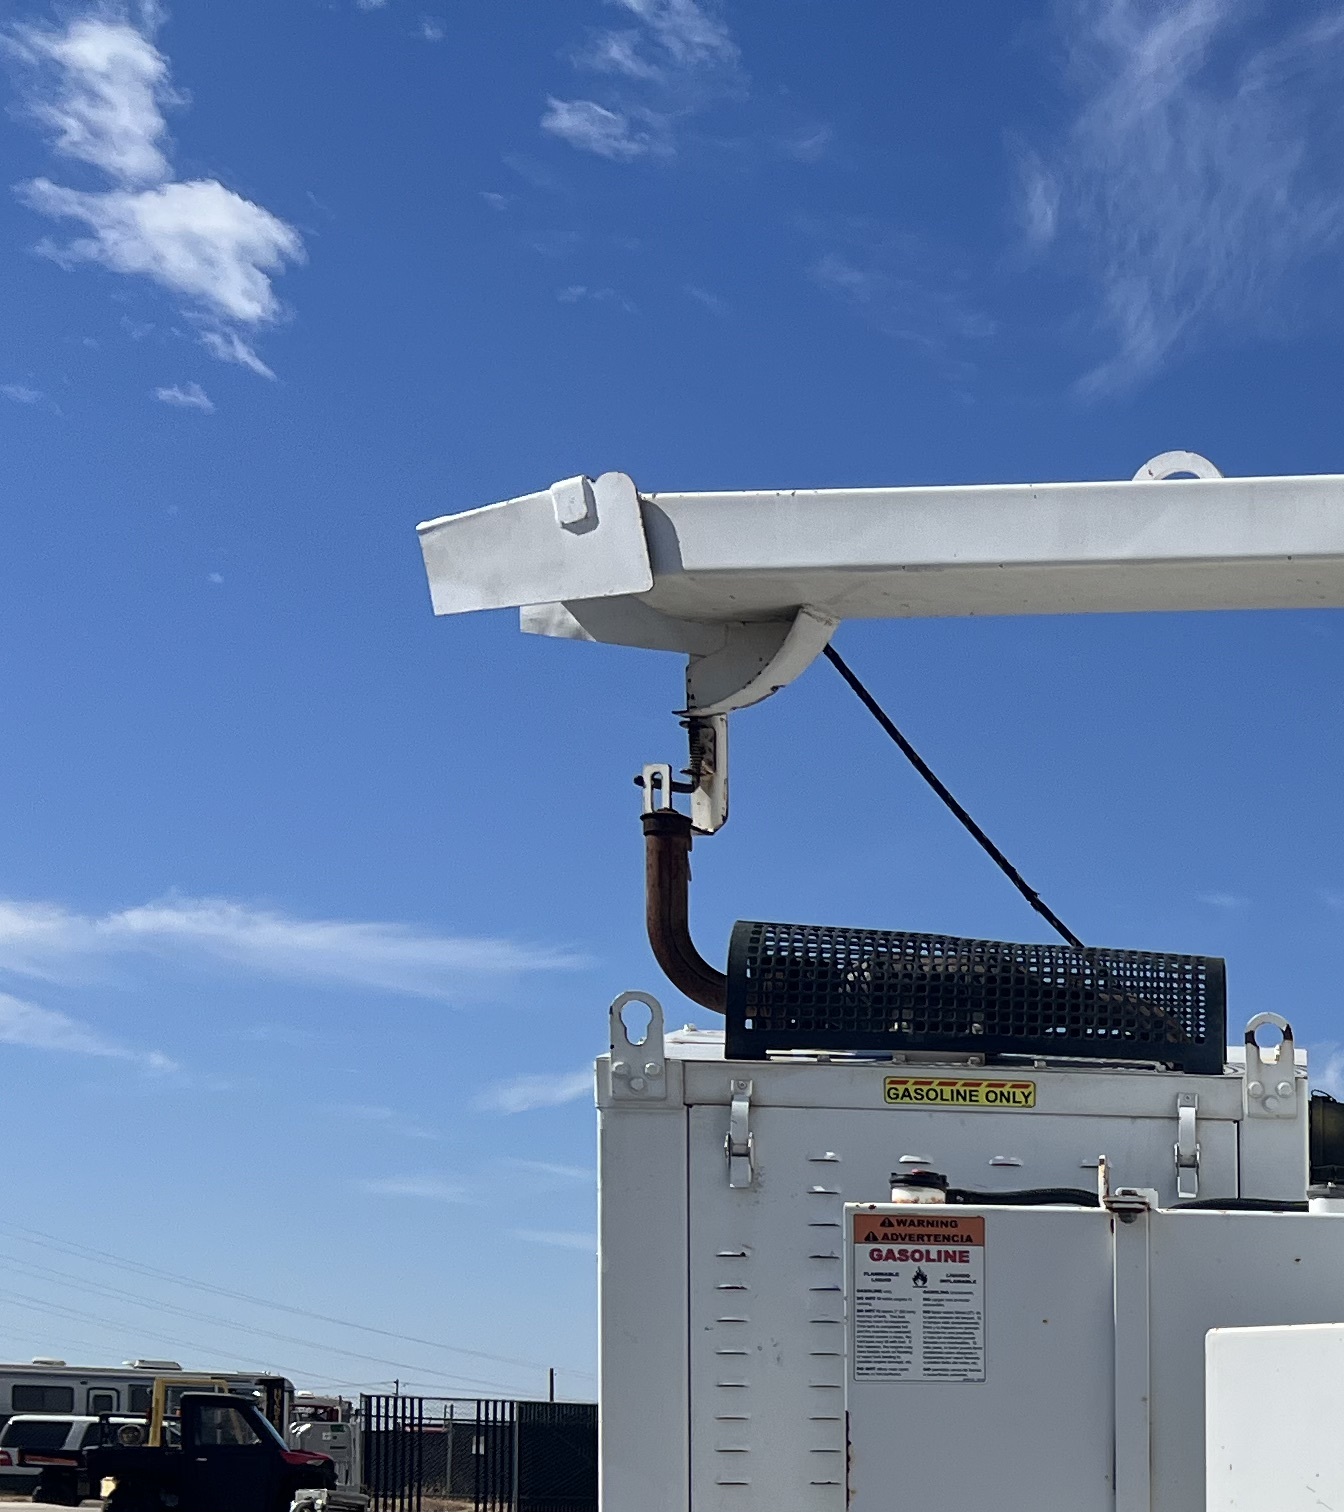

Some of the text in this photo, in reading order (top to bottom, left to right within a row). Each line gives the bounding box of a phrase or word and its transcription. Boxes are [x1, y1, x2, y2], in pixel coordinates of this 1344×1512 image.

[886, 1086, 1033, 1105] GASOLINE ONLY
[896, 1218, 958, 1229] WARNING
[881, 1232, 973, 1243] ADVERTENCIA
[869, 1248, 970, 1264] GASOLINE
